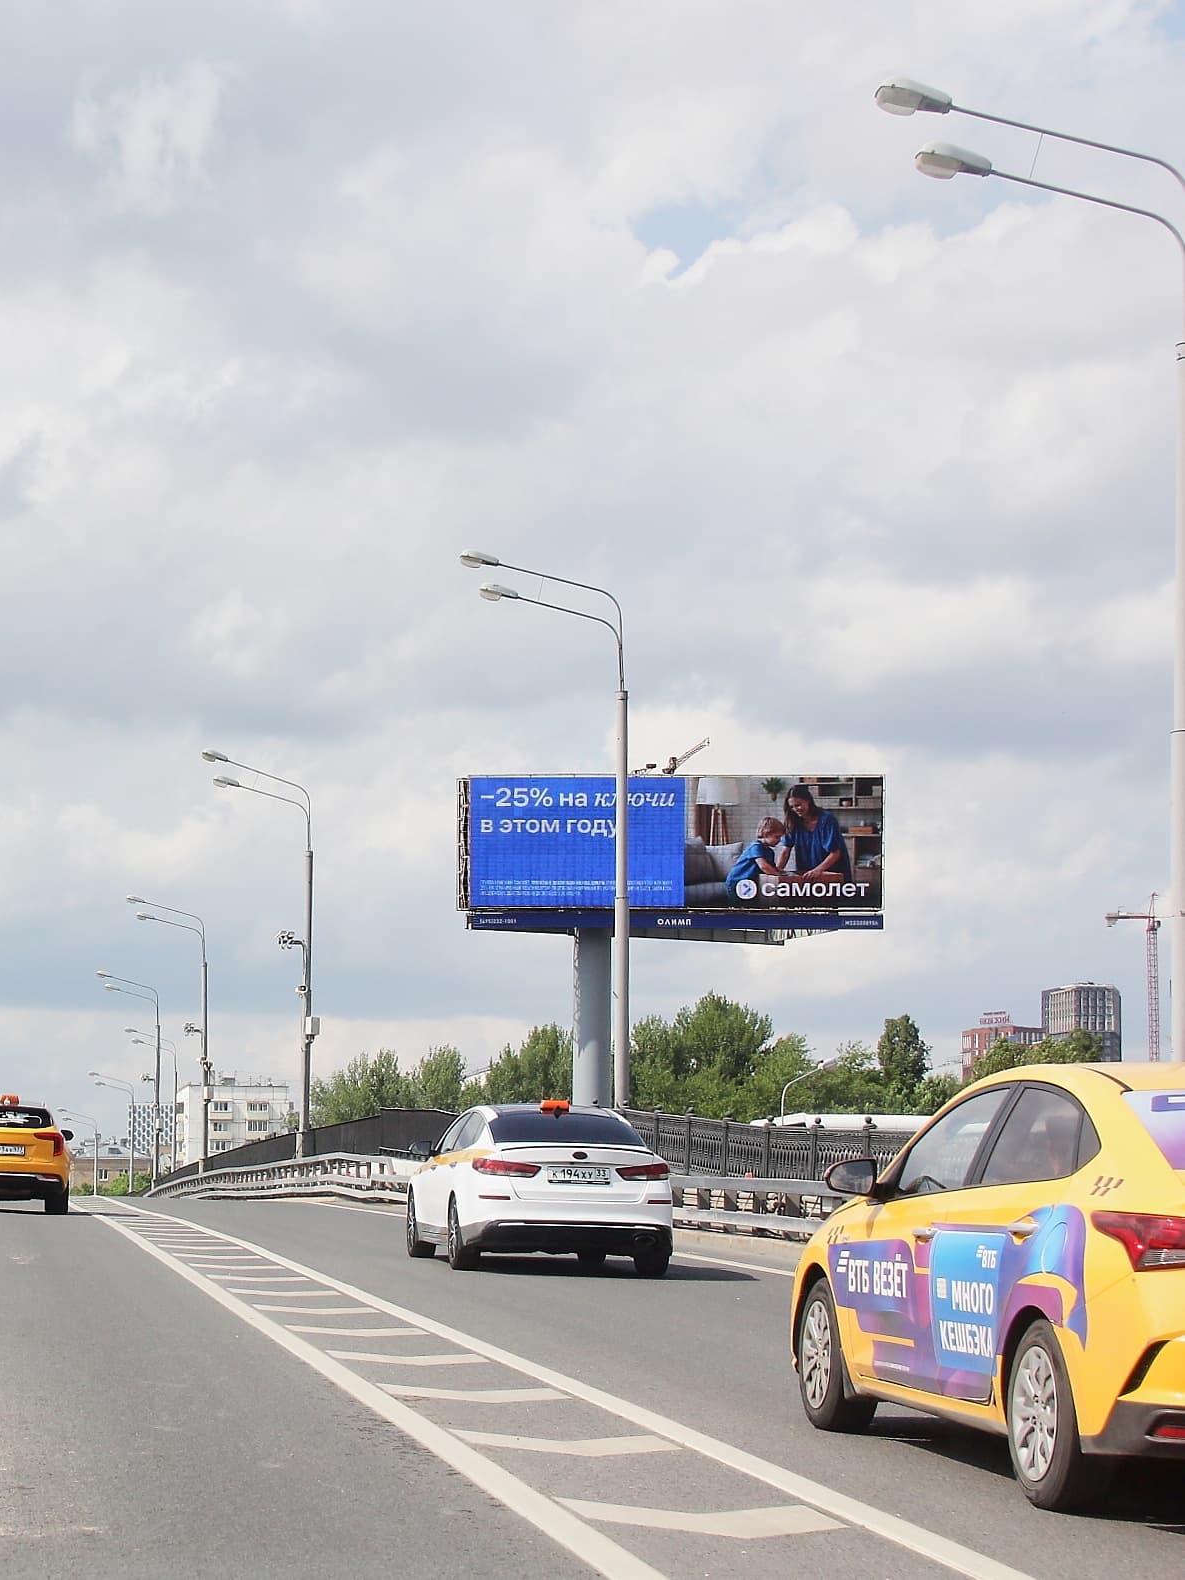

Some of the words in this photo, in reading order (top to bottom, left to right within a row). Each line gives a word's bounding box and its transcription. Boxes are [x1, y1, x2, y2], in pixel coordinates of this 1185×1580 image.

[559, 792, 588, 807] на
[480, 819, 493, 833] в
[499, 819, 560, 833] этом
[761, 881, 870, 897] самолет
[657, 918, 692, 926] ОЛИМП
[981, 1249, 998, 1269] ВТБ
[848, 1258, 870, 1294] ВТБ
[873, 1253, 909, 1298] ВЕЗЁТ
[951, 1280, 994, 1315] МНОГО
[939, 1320, 994, 1358] КЕШБЭКА
